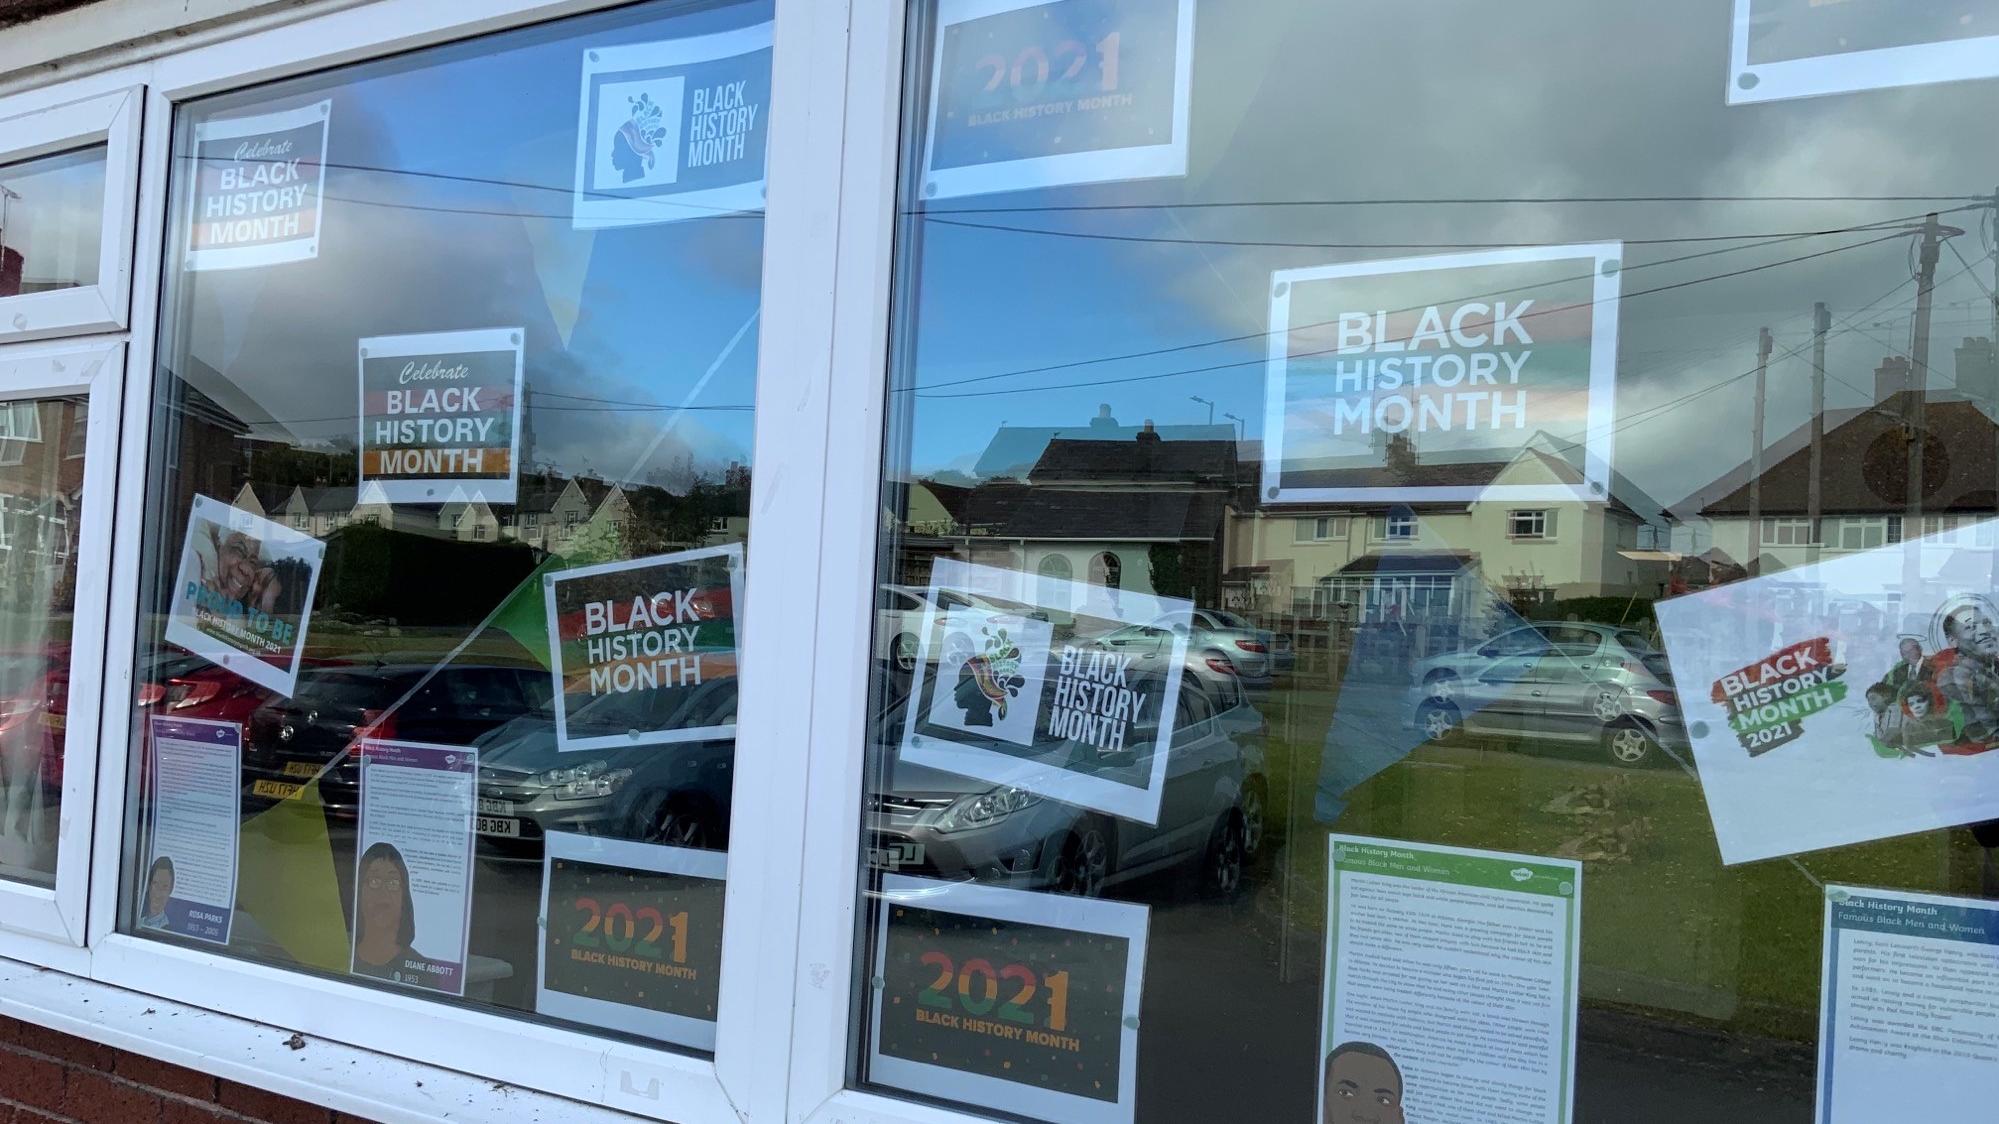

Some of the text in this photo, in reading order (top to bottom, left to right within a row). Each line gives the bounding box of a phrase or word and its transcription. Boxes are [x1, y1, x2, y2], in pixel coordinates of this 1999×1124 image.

[972, 31, 1121, 106] 2021
[692, 80, 747, 115] BLACK
[968, 92, 1135, 127] BLACK HISTORY MONTH
[690, 104, 758, 142] HISTORY
[234, 139, 292, 162] Celebrate
[688, 134, 745, 168] MONTH
[220, 158, 300, 190] BLACK
[206, 184, 307, 218] HISTORY
[210, 215, 300, 245] MONTH
[1337, 300, 1536, 355] BLACK
[399, 360, 470, 385] Celebrate
[1335, 350, 1532, 392] HISTORY
[387, 386, 482, 415] BLACK
[1333, 390, 1527, 435] MONTH
[376, 418, 496, 444] HISTORY
[380, 448, 484, 475] MONTH
[248, 607, 269, 634] TO
[272, 618, 293, 646] BE
[585, 588, 700, 636] BLACK
[240, 628, 266, 648] MONTH
[264, 641, 282, 654] 2021
[588, 626, 700, 664] HISTORY
[590, 655, 700, 696] MONTH
[1060, 644, 1132, 688] BLACK
[1720, 646, 1818, 698] BLACK
[1054, 676, 1146, 724] HISTORY
[1732, 667, 1831, 712] HISTORY
[1736, 688, 1834, 732] MONTH
[1048, 706, 1128, 752] MONTH
[1746, 723, 1792, 748] 2021
[1361, 847, 1388, 858] History
[1368, 859, 1388, 868] Black
[1390, 862, 1404, 870] Men
[1406, 864, 1420, 872] and
[1838, 912, 1985, 934] Famous Black Men and Women
[1868, 900, 1904, 914] History
[1907, 904, 1938, 916] Month
[572, 898, 689, 964] 2021
[404, 960, 454, 976] DIANE ABBOTT
[404, 974, 419, 984] 1953
[572, 949, 697, 980] BLACK HISTORY MONTH
[917, 952, 1069, 1032] 2021
[916, 1008, 1080, 1052] BLACK HISTORY MONTH
